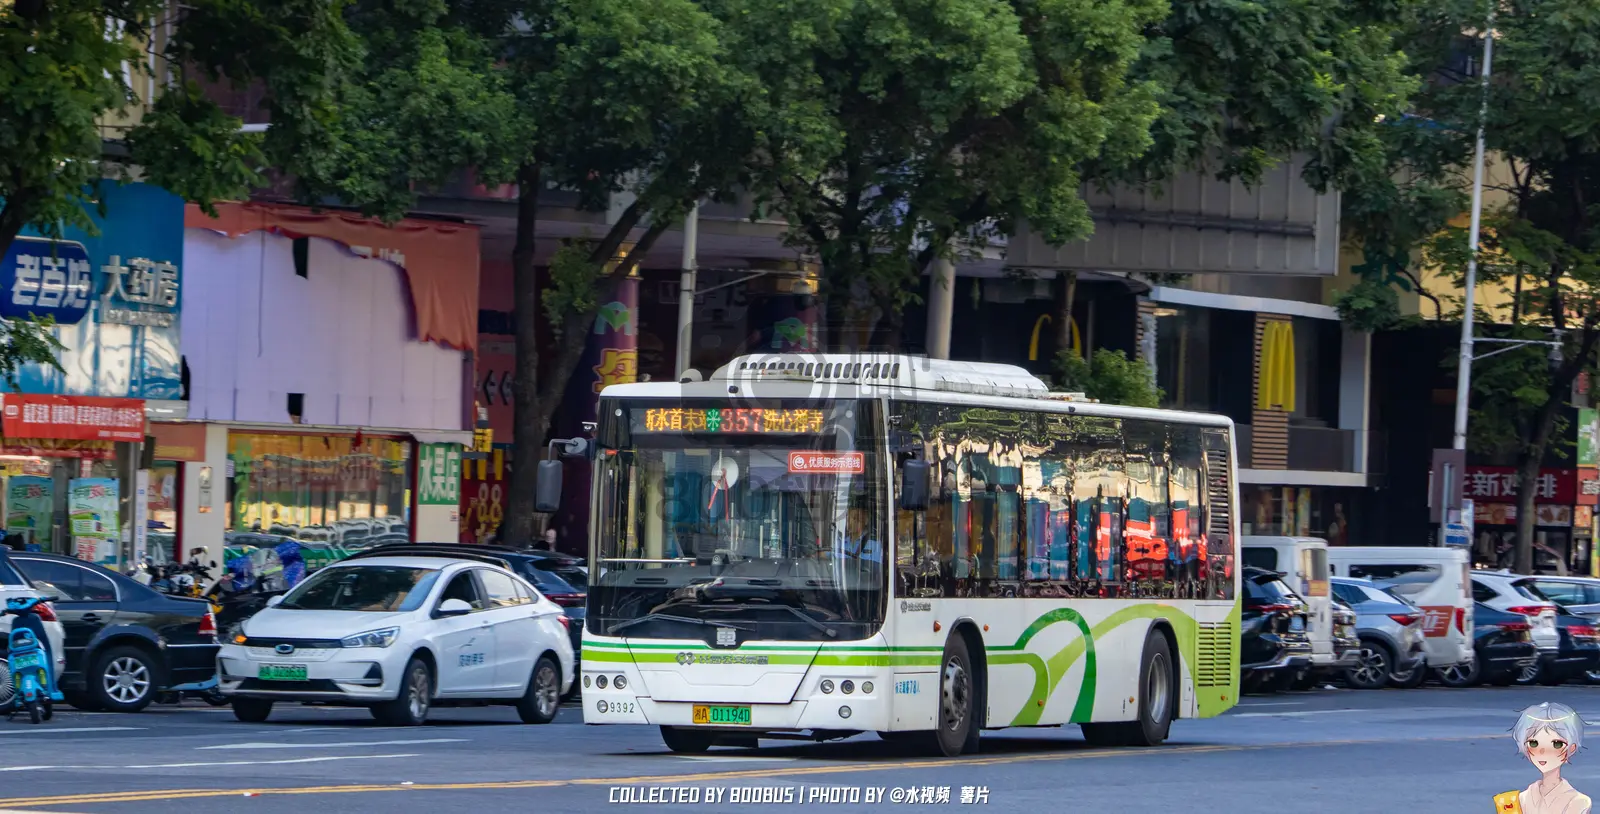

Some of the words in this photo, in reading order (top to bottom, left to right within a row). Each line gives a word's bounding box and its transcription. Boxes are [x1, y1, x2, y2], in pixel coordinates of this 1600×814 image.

[11, 253, 91, 309] 老百姓
[100, 255, 179, 308] 大药房
[720, 408, 764, 432] 357
[763, 408, 824, 433] 洗心禅寺
[419, 445, 459, 501] 水果店
[809, 456, 861, 469] 优质服务示范线
[610, 702, 634, 713] 9392
